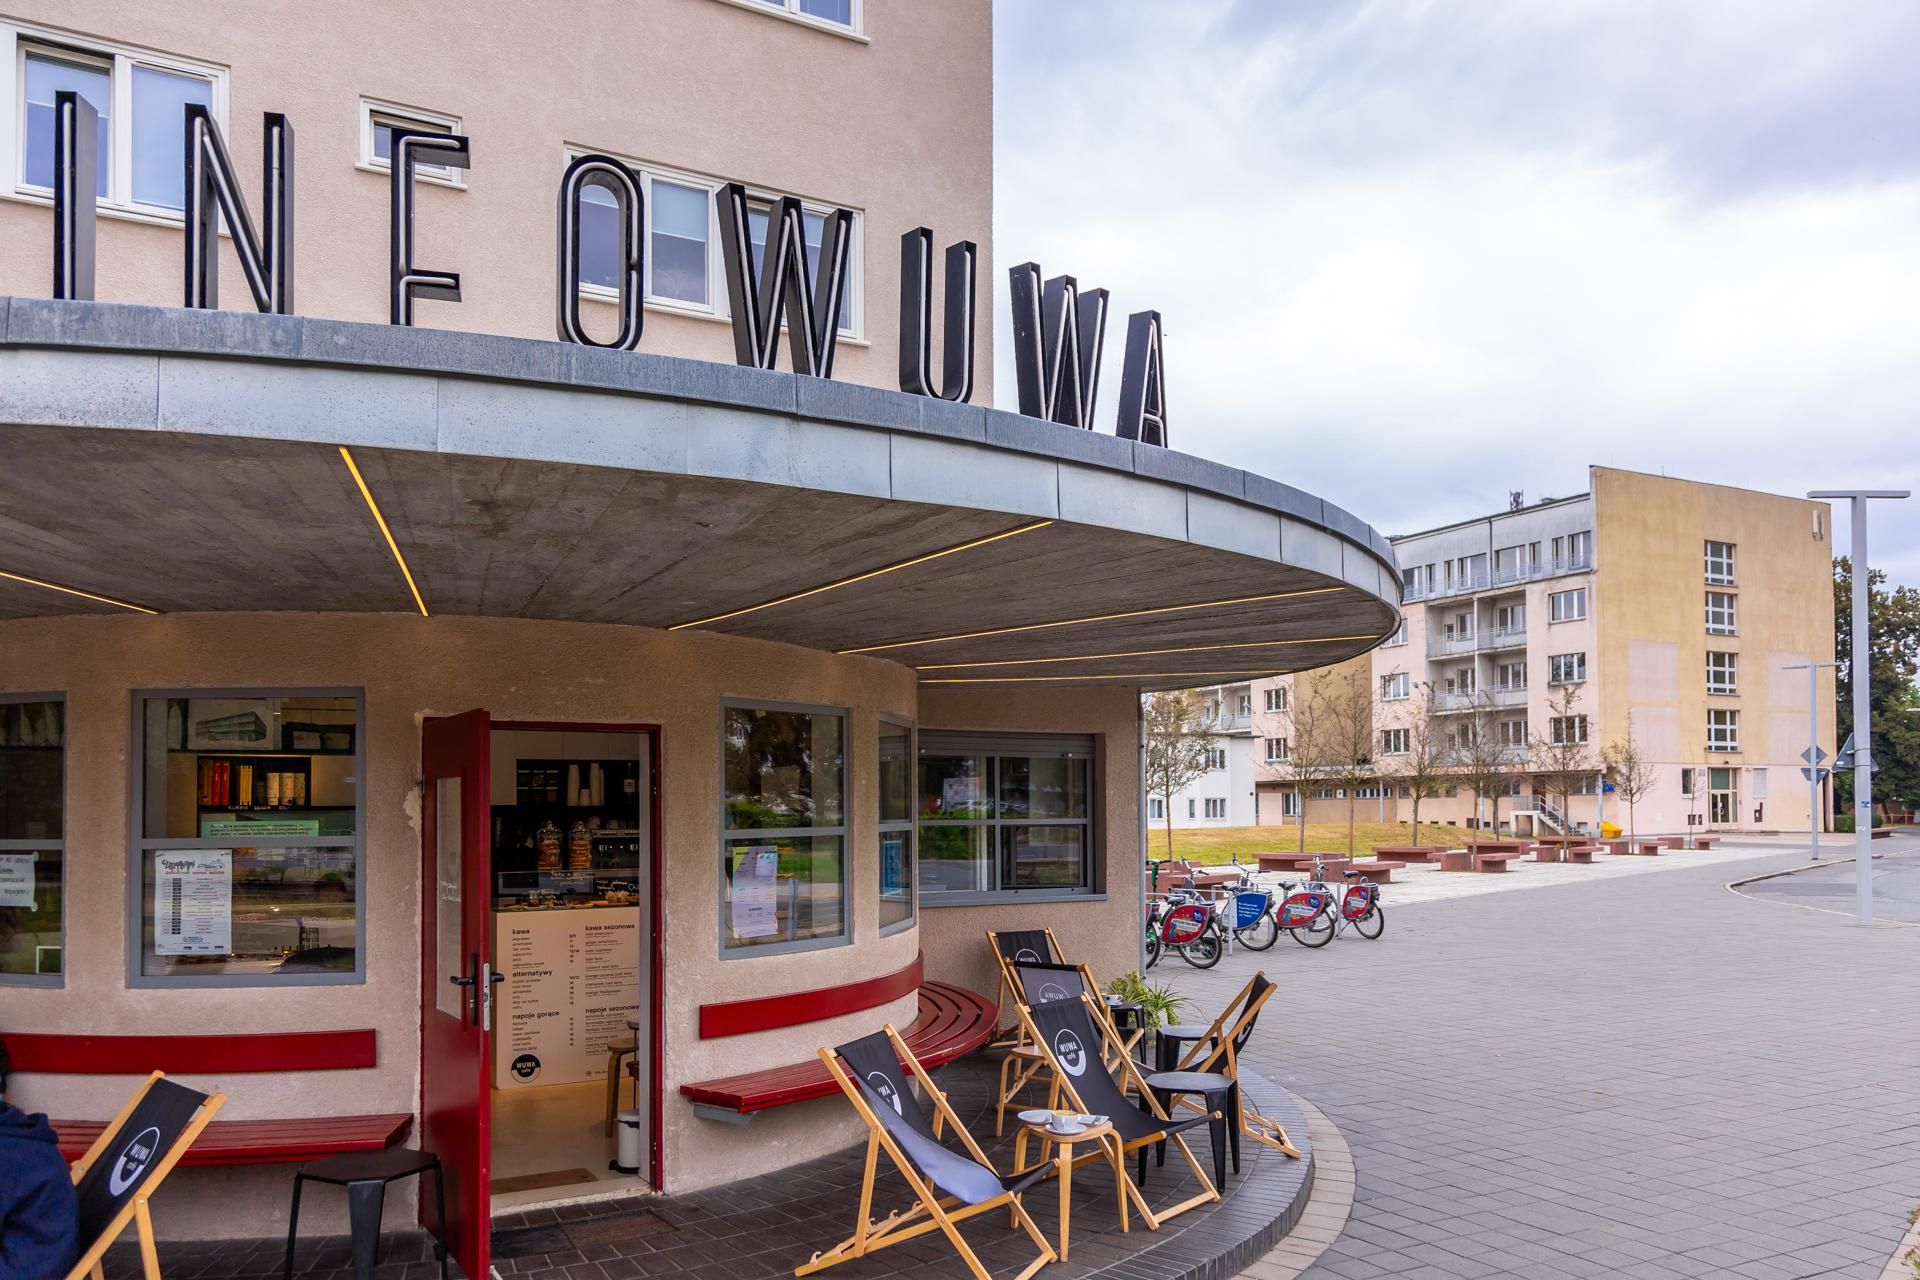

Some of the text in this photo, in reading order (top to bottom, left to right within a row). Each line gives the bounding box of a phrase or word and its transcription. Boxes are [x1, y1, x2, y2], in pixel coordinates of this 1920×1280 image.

[512, 969, 553, 978] alternatywy
[585, 1006, 607, 1014] napoje
[512, 1010, 560, 1020] napoje gorące
[1059, 1041, 1078, 1053] WUWA
[516, 1061, 536, 1069] WUWA
[130, 1143, 150, 1161] WUWA
